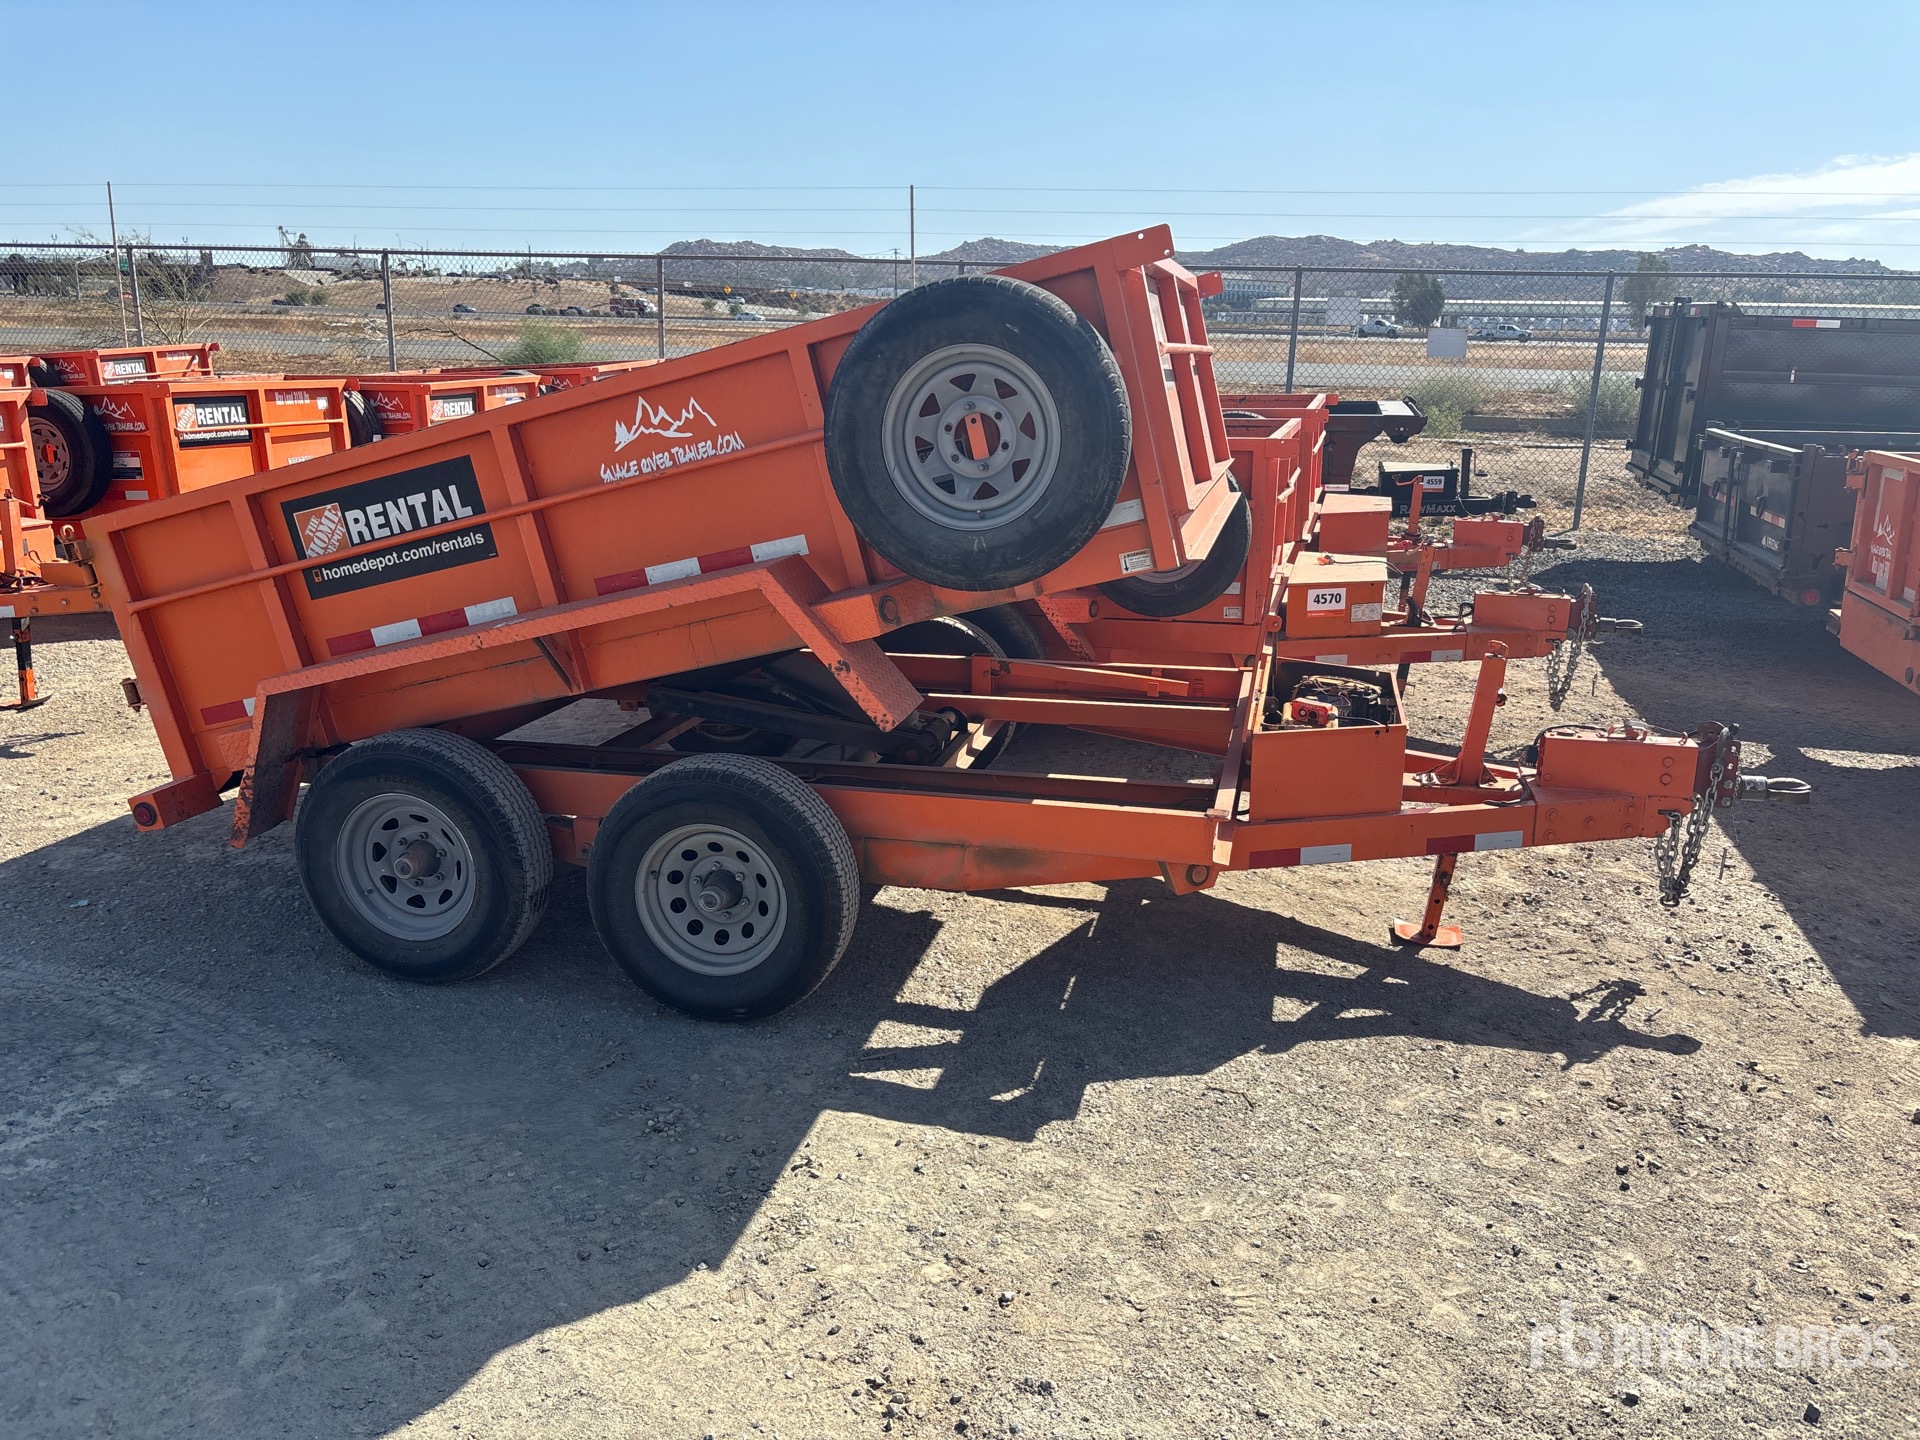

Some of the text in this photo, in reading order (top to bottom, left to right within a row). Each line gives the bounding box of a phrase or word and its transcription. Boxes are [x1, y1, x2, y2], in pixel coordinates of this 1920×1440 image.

[115, 362, 146, 375] RENTAL
[196, 406, 246, 425] RENTAL
[444, 401, 475, 416] RENTAL
[183, 429, 250, 441] homedepot.com/rentals
[600, 430, 745, 484] SNAKE RIVER TRAILER.COM
[1426, 478, 1442, 486] 4559
[344, 484, 474, 544] RENTAL
[304, 514, 321, 537] THE
[307, 505, 342, 558] HOME
[322, 531, 485, 581] homedepot.com/rentals
[1313, 592, 1342, 605] 4570
